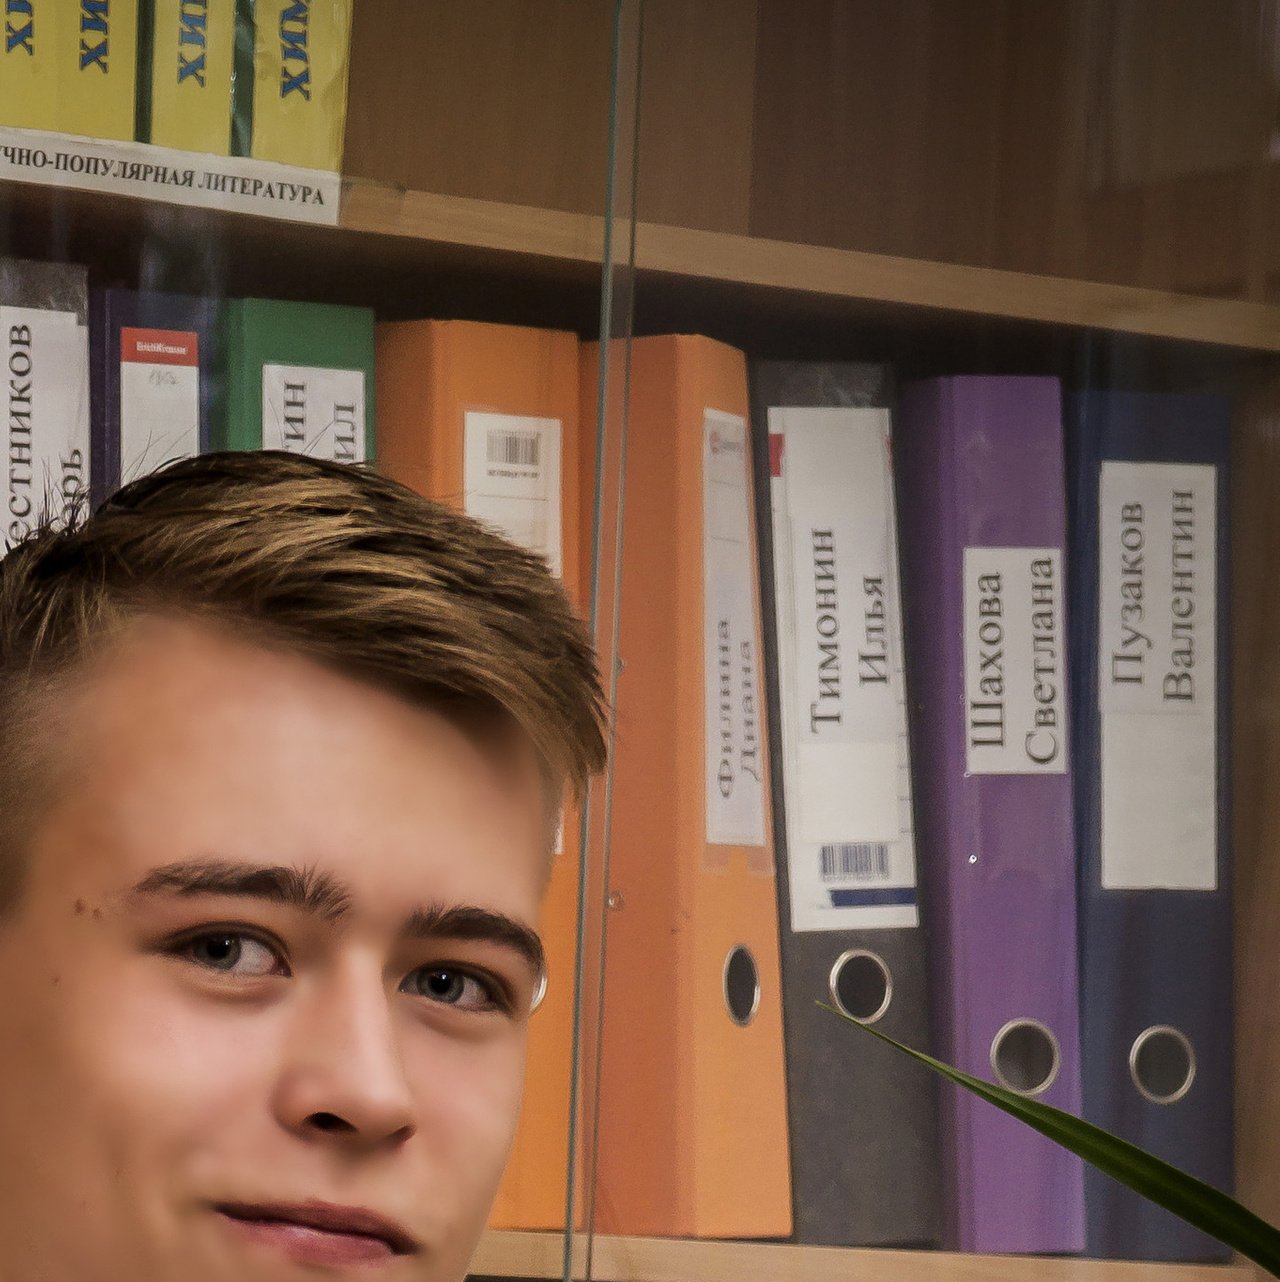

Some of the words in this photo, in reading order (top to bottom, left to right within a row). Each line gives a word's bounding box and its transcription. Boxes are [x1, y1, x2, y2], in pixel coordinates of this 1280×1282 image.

[198, 171, 325, 206] ЛИТЕРАТУРА
[8, 322, 32, 541] естников
[810, 526, 842, 734] Тимонин
[856, 574, 889, 688] Илья
[970, 571, 1005, 748] Шахова
[1024, 556, 1058, 766] Светлана
[1111, 500, 1153, 687] Пузаков
[1162, 487, 1196, 703] Валентин
[739, 639, 762, 785] Диана
